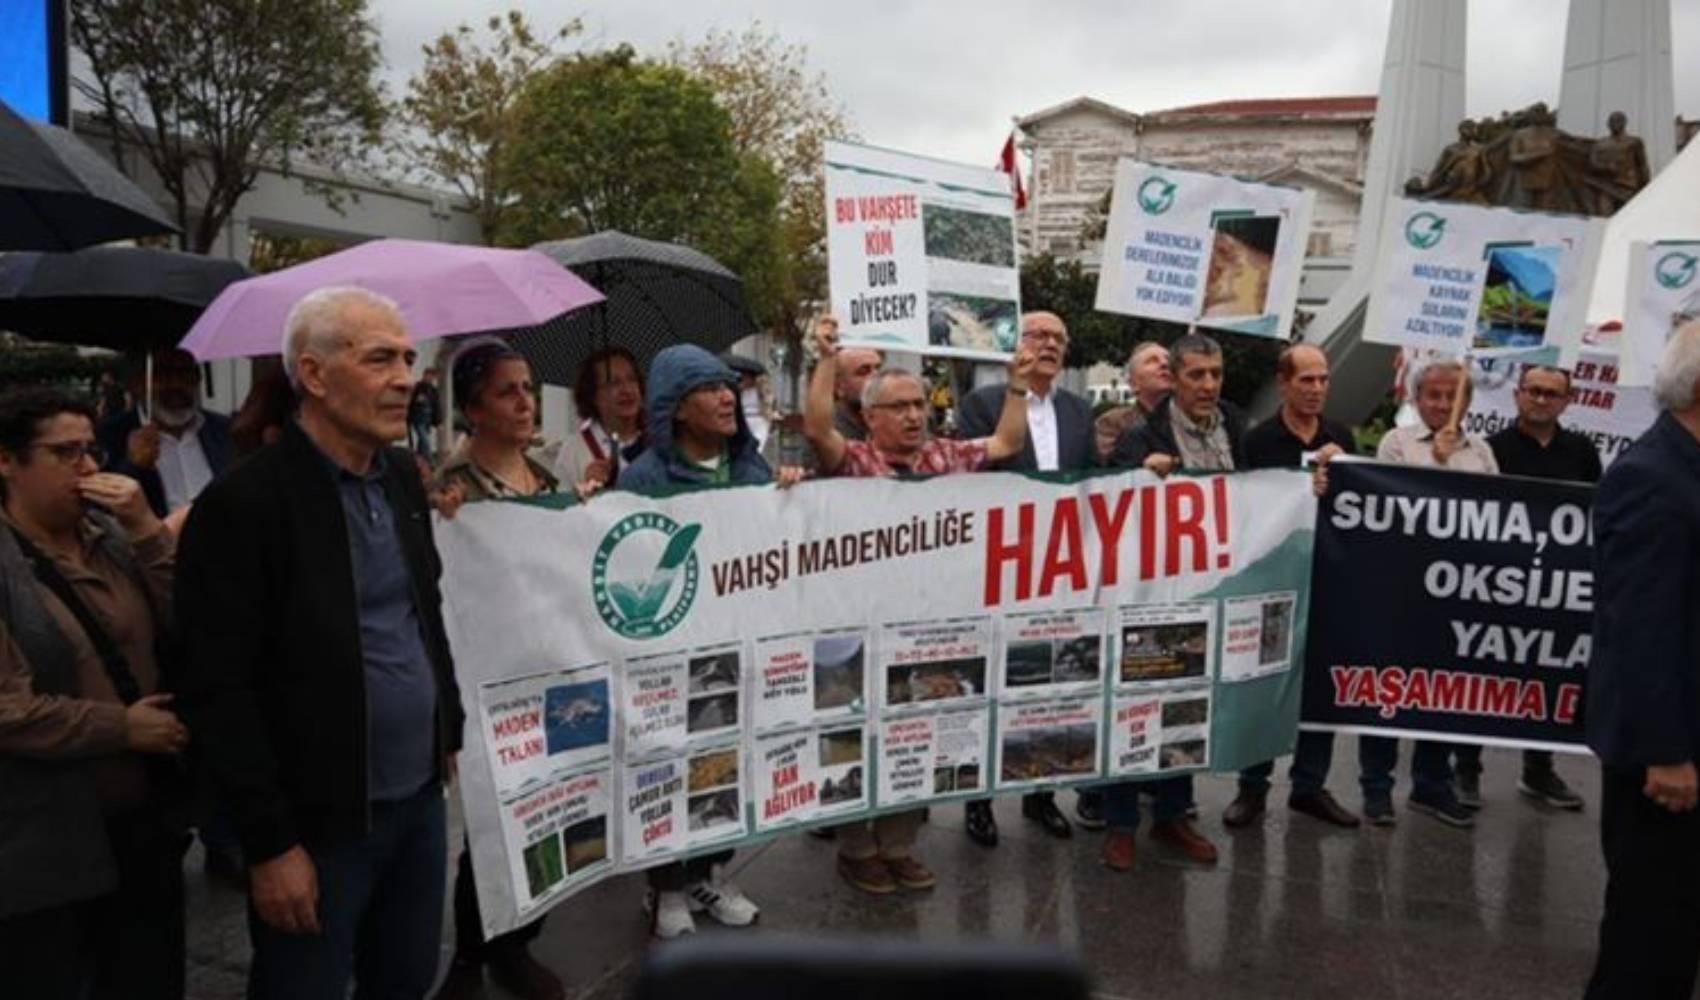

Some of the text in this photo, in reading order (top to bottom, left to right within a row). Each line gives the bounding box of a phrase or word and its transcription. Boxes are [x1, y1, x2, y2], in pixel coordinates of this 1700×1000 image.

[836, 195, 918, 224] BU VAHŞETE
[865, 224, 893, 255] KİM
[868, 261, 898, 287] DUR
[850, 293, 917, 325] DİYECEK?
[1136, 287, 1155, 302] YOK
[1331, 490, 1594, 553] SUYUMA,O
[797, 508, 975, 577] MADENCİLİĞE
[983, 476, 1230, 608] HAYIR!
[711, 538, 789, 598] VAHŞİ
[1424, 557, 1595, 612] OKSİJE
[1451, 620, 1593, 669] YAYLA
[1331, 665, 1547, 719] YAŞAMIMA
[493, 709, 539, 739] MADEN
[772, 763, 798, 789] KAN
[764, 782, 816, 819] AĞLIYOR
